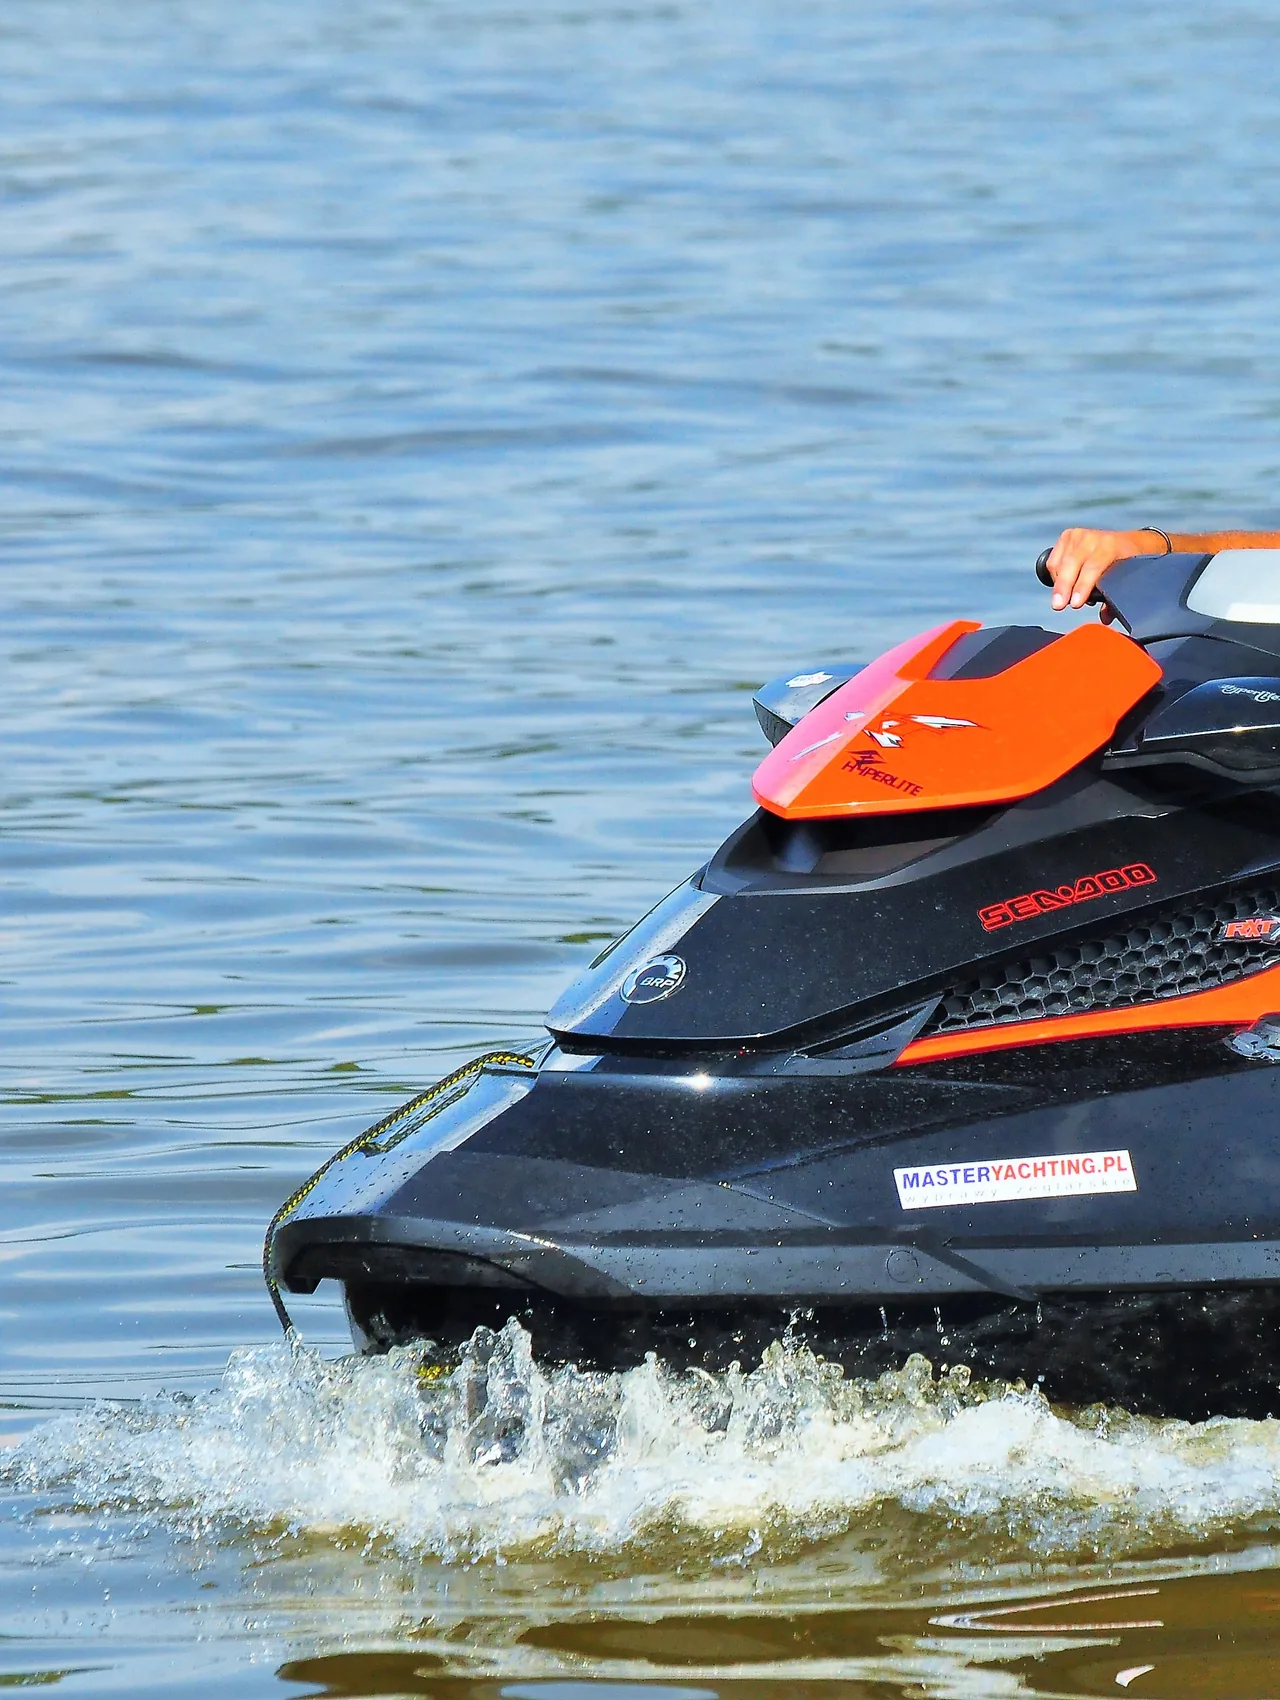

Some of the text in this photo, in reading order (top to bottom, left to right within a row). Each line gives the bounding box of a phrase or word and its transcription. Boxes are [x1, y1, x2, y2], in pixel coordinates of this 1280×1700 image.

[841, 760, 924, 797] HYPERLITE
[640, 976, 675, 988] BRP
[902, 1155, 1129, 1190] MASTERYACHTING.PL
